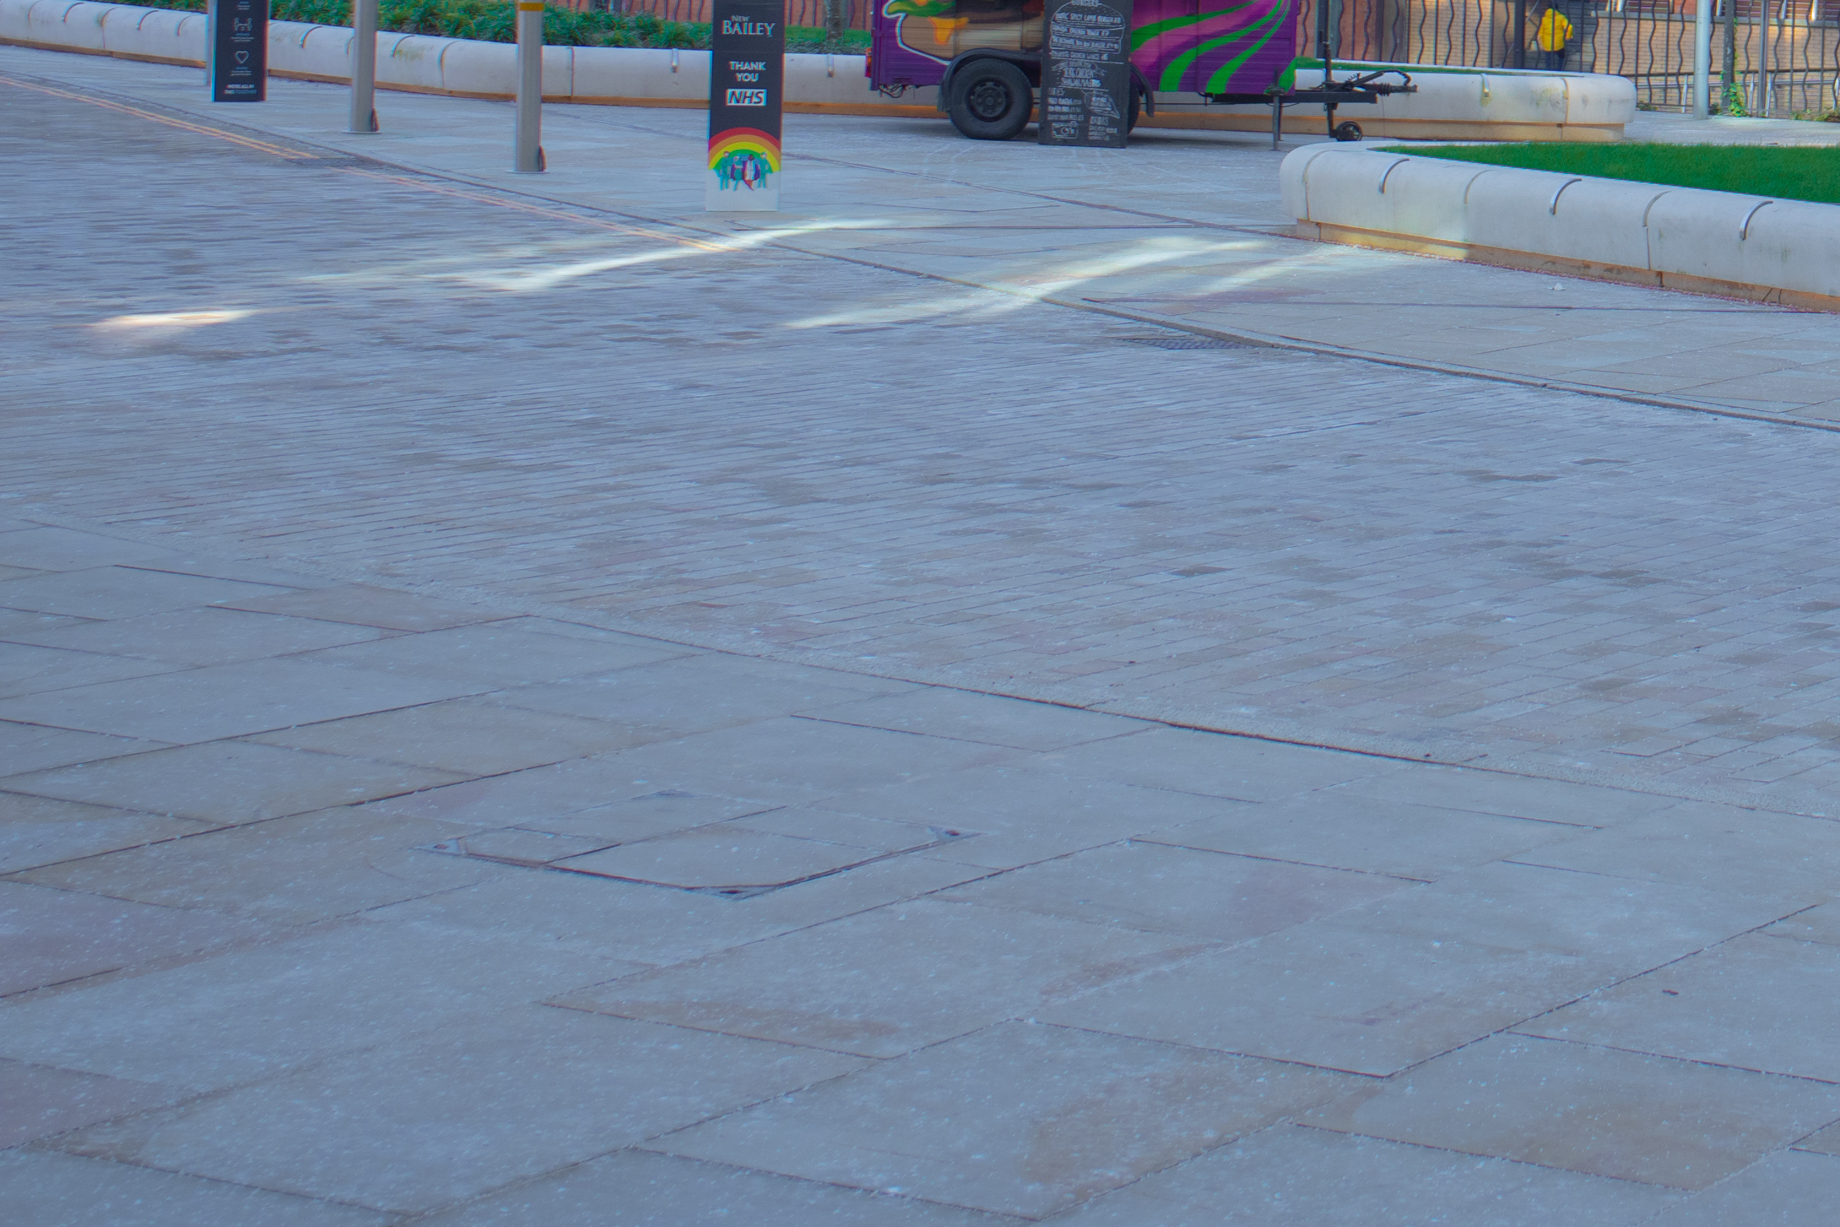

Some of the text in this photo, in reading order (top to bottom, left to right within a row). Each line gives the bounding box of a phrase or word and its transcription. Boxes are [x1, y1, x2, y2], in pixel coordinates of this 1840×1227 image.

[722, 20, 775, 37] BAILEY
[729, 61, 766, 71] THANK
[735, 72, 759, 82] YOU
[728, 90, 765, 105] NHS
